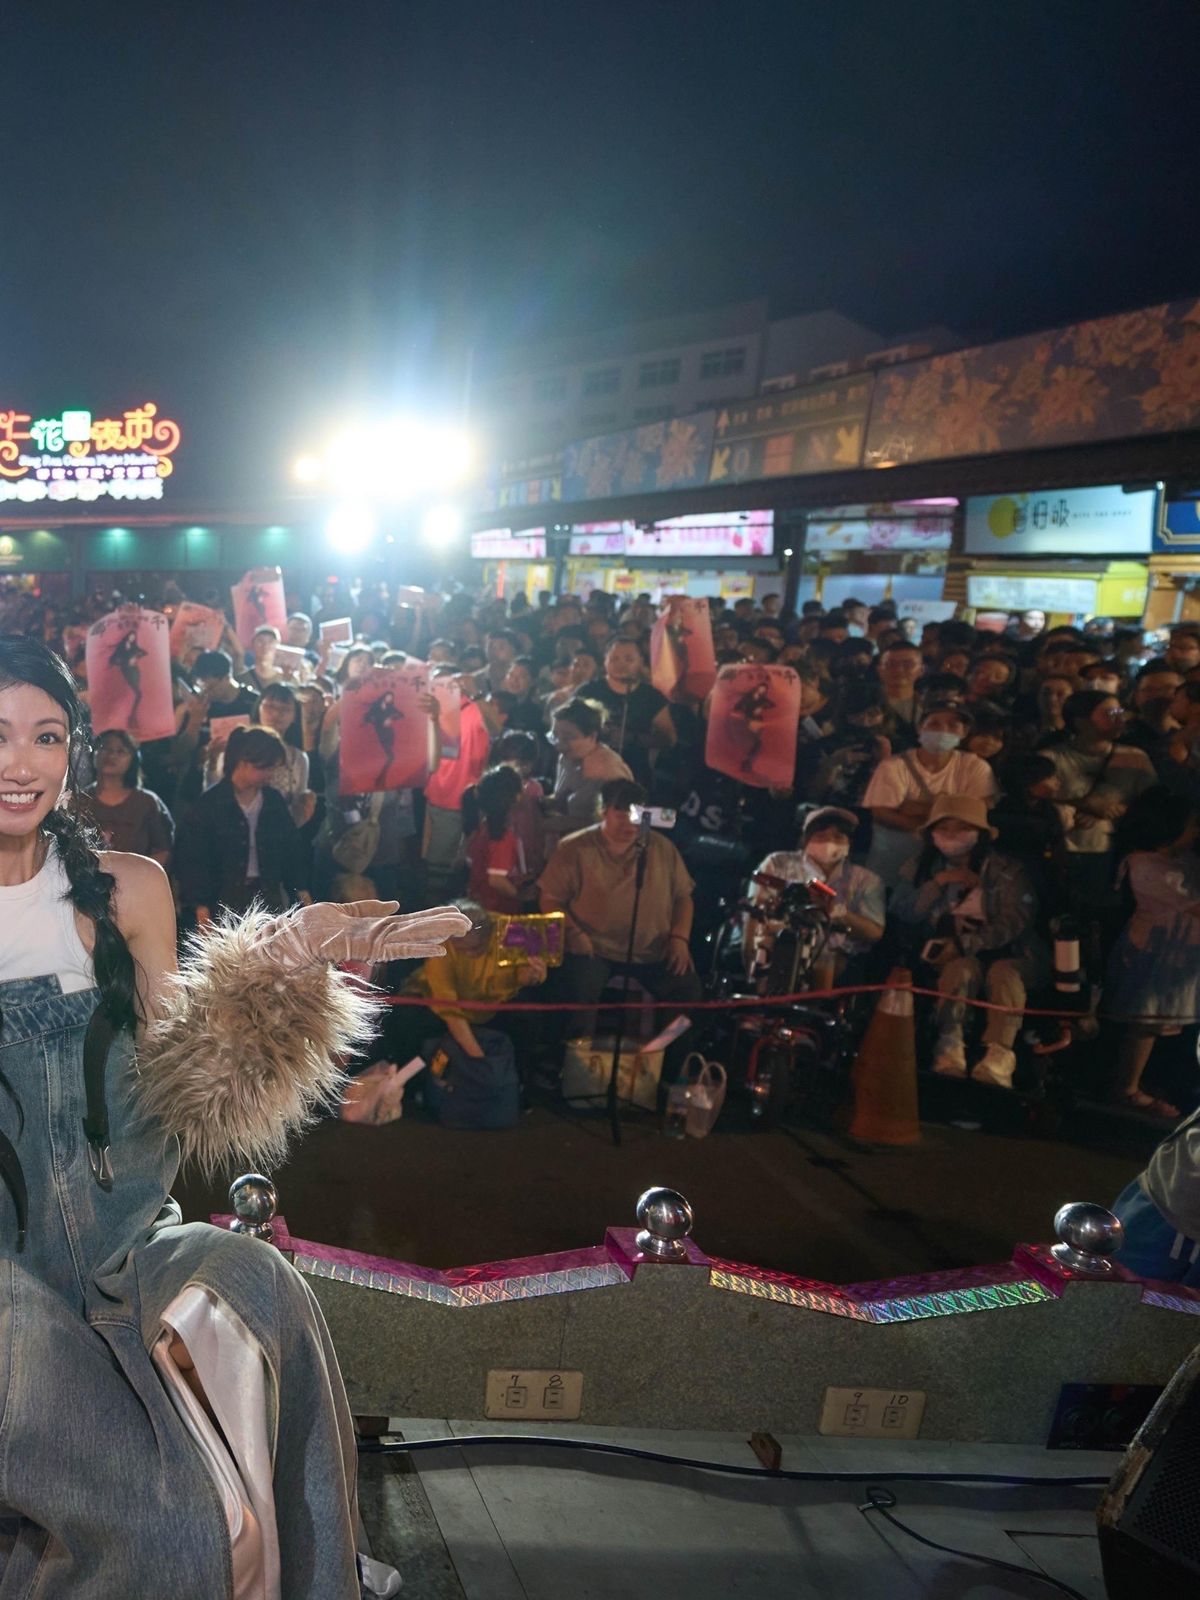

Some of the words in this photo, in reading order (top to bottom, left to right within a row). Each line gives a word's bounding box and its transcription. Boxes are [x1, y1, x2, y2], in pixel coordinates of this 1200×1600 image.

[548, 1374, 563, 1388] 8
[853, 1391, 864, 1406] 9
[889, 1394, 909, 1405] 10
